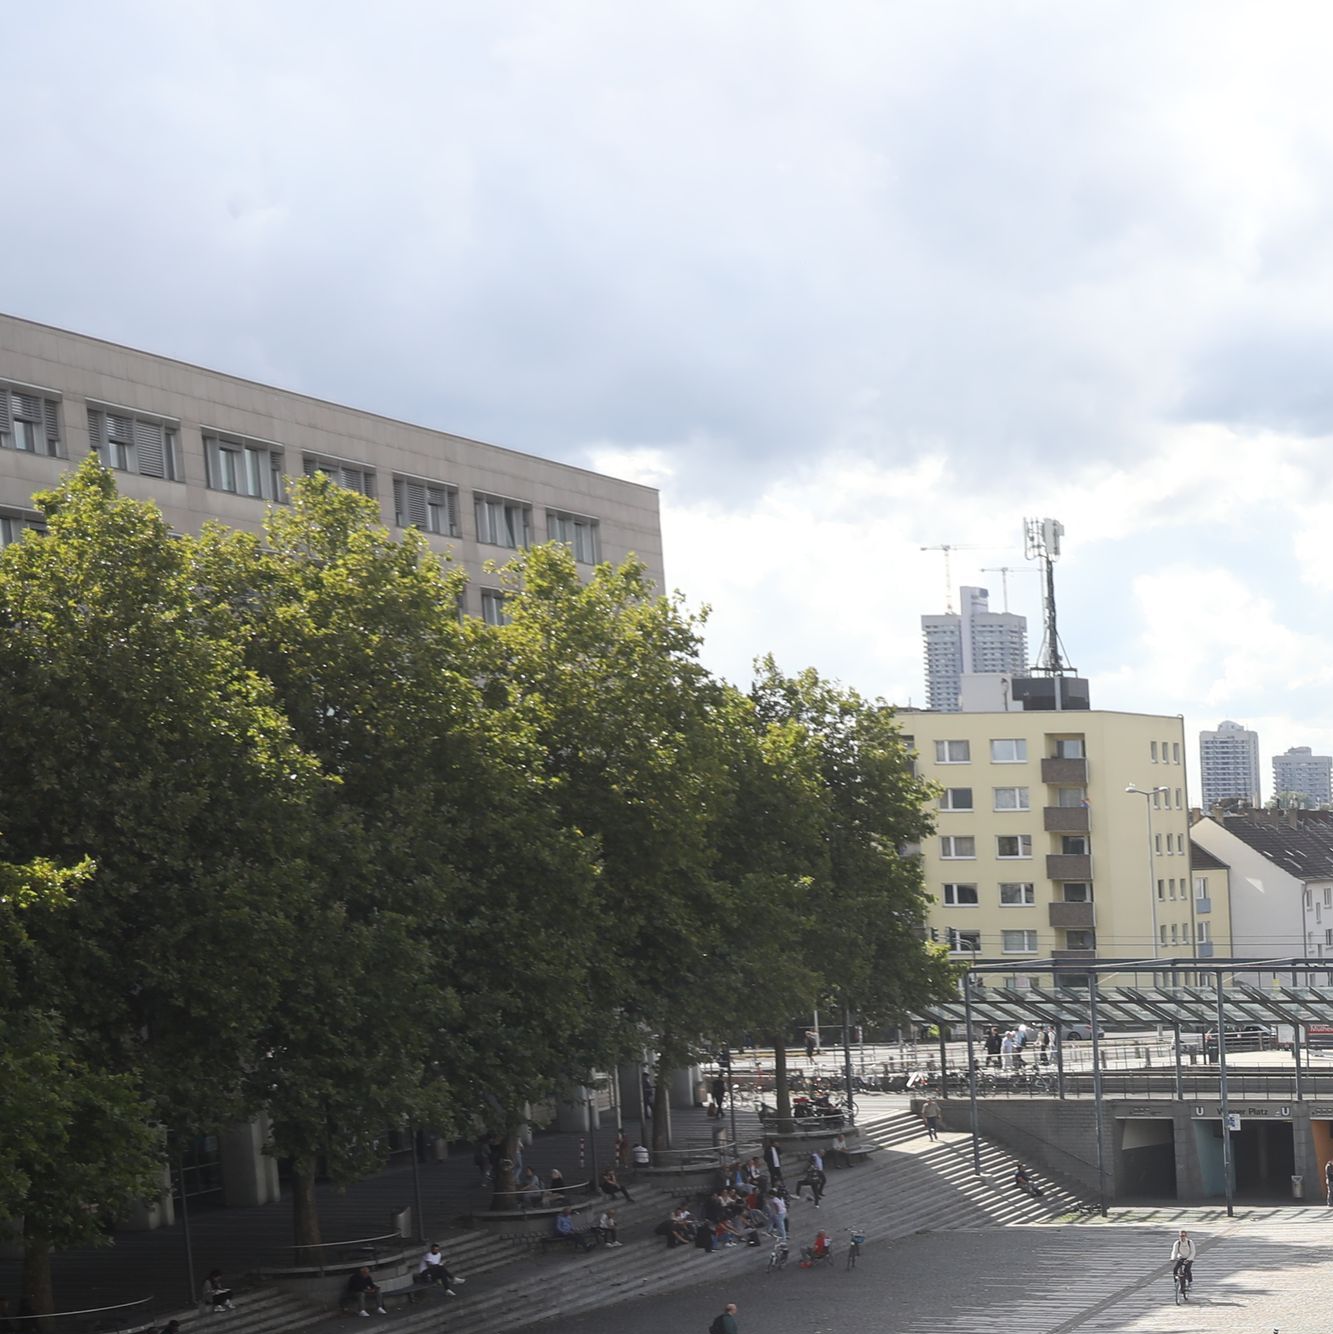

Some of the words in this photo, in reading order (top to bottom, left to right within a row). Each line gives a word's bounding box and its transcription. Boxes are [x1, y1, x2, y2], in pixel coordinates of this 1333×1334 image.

[1196, 1107, 1204, 1116] U
[1248, 1107, 1268, 1116] Platz
[1281, 1107, 1290, 1116] U
